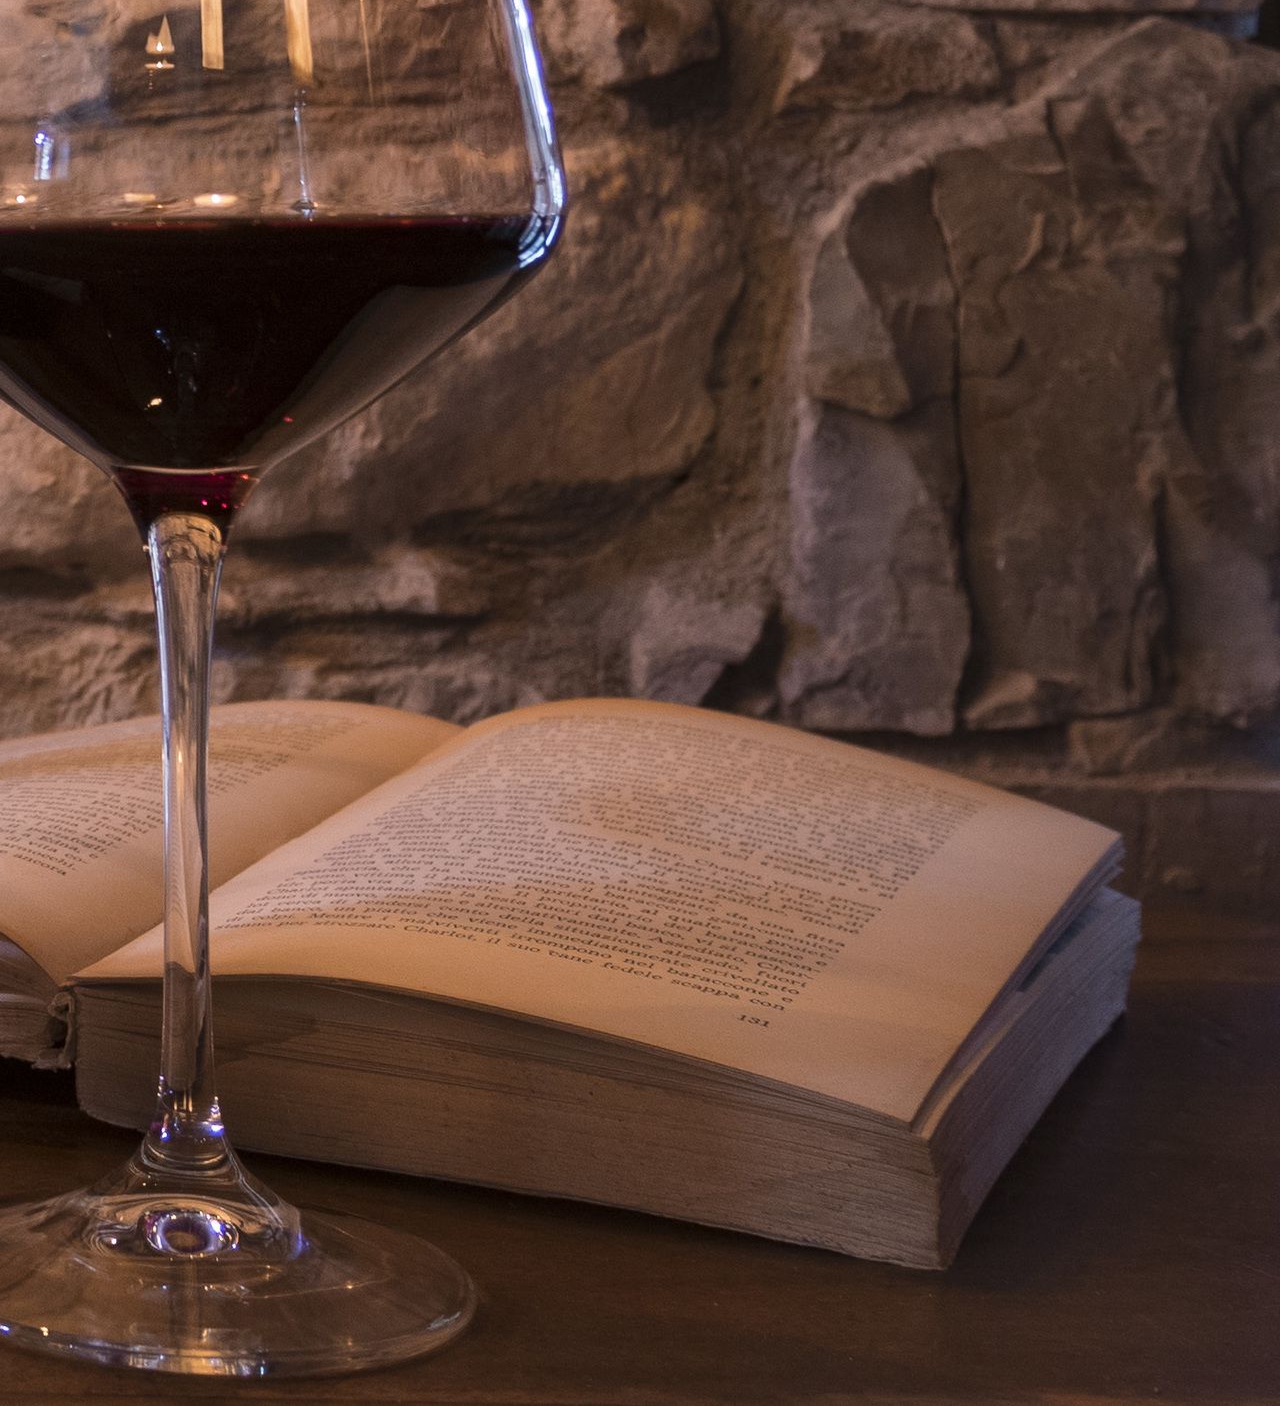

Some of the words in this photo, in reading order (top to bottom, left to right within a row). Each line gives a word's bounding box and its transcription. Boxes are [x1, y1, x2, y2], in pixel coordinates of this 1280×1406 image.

[13, 854, 66, 876] ancora
[314, 920, 396, 929] strozzare
[507, 941, 542, 953] suo
[547, 949, 594, 964] cane
[602, 960, 663, 981] fedele
[670, 978, 741, 999] scappa
[748, 997, 786, 1011] con
[356, 899, 431, 908] rendersi
[438, 905, 490, 916] conto
[498, 911, 545, 926] della
[554, 923, 654, 950] situazione
[756, 968, 810, 988] fuori
[362, 906, 418, 915] piatto
[426, 911, 459, 920] che
[468, 916, 518, 929] viene
[527, 925, 692, 968] immediatamente
[701, 966, 802, 995] crivellato
[399, 917, 500, 935] malviventi
[511, 931, 613, 959] irrompono
[623, 957, 656, 969] nel
[666, 965, 770, 997] baraccone
[736, 1014, 769, 1028] 131
